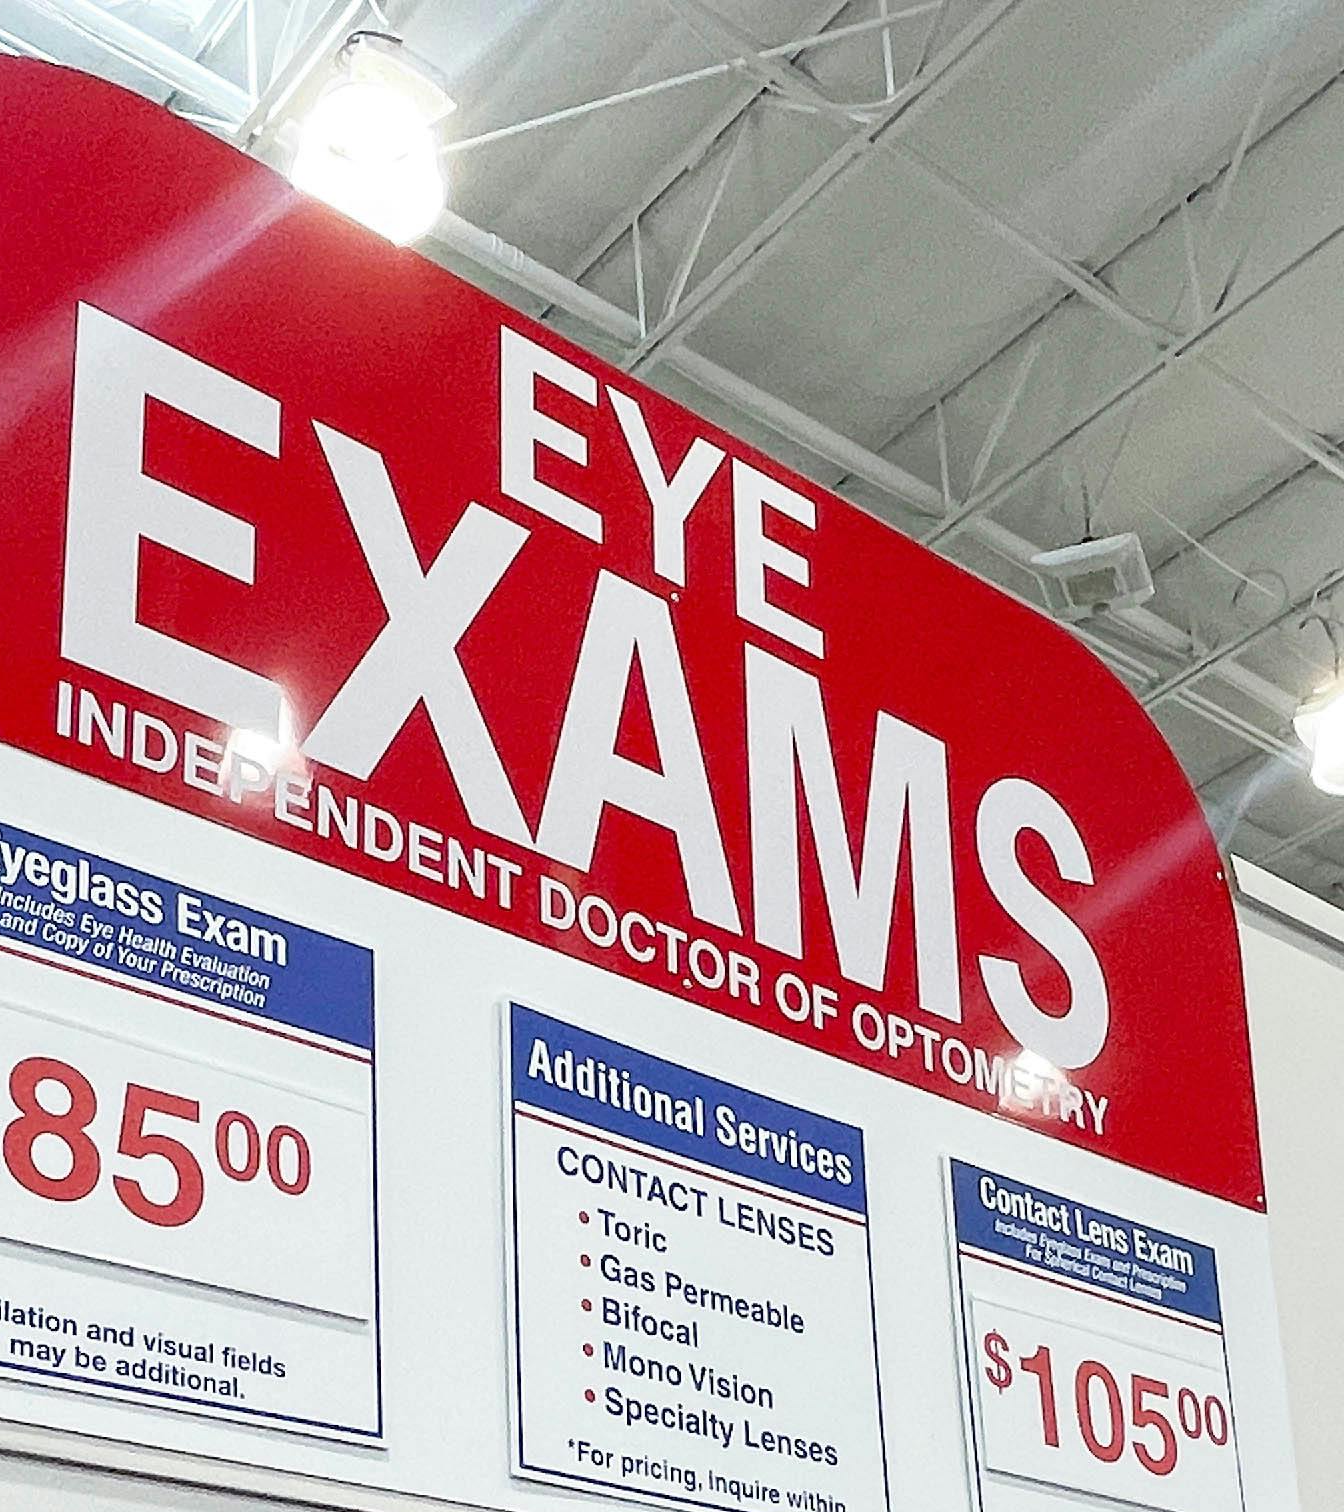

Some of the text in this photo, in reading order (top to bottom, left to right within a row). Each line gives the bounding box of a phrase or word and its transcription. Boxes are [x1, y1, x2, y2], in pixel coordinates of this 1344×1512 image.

[499, 325, 827, 659] EYE
[58, 300, 1110, 1072] EXAMS
[55, 679, 1108, 1136] INDEPENDENT DOCTOR OF OPTOMETRY
[176, 892, 287, 966] Exam
[0, 912, 266, 1009] and Copy of Your Prescription
[80, 912, 114, 941] Eye
[118, 925, 177, 961] Health
[180, 946, 270, 990] Evaluation
[528, 1038, 852, 1186] Additional Services
[557, 1145, 835, 1256] CONTACT LENSES
[598, 1208, 668, 1253] Toric
[979, 1176, 1195, 1276] Contact Lens Exam
[600, 1254, 805, 1334] Gas Permeable
[602, 1296, 699, 1348] Bifocal
[9, 1337, 246, 1399] may be additional.
[86, 1322, 135, 1348] and
[143, 1331, 215, 1364] visual
[222, 1346, 286, 1378] fields
[603, 1341, 773, 1409] Mono Vision
[604, 1386, 838, 1466] Specialty Lenses
[621, 1454, 703, 1492] pricing,
